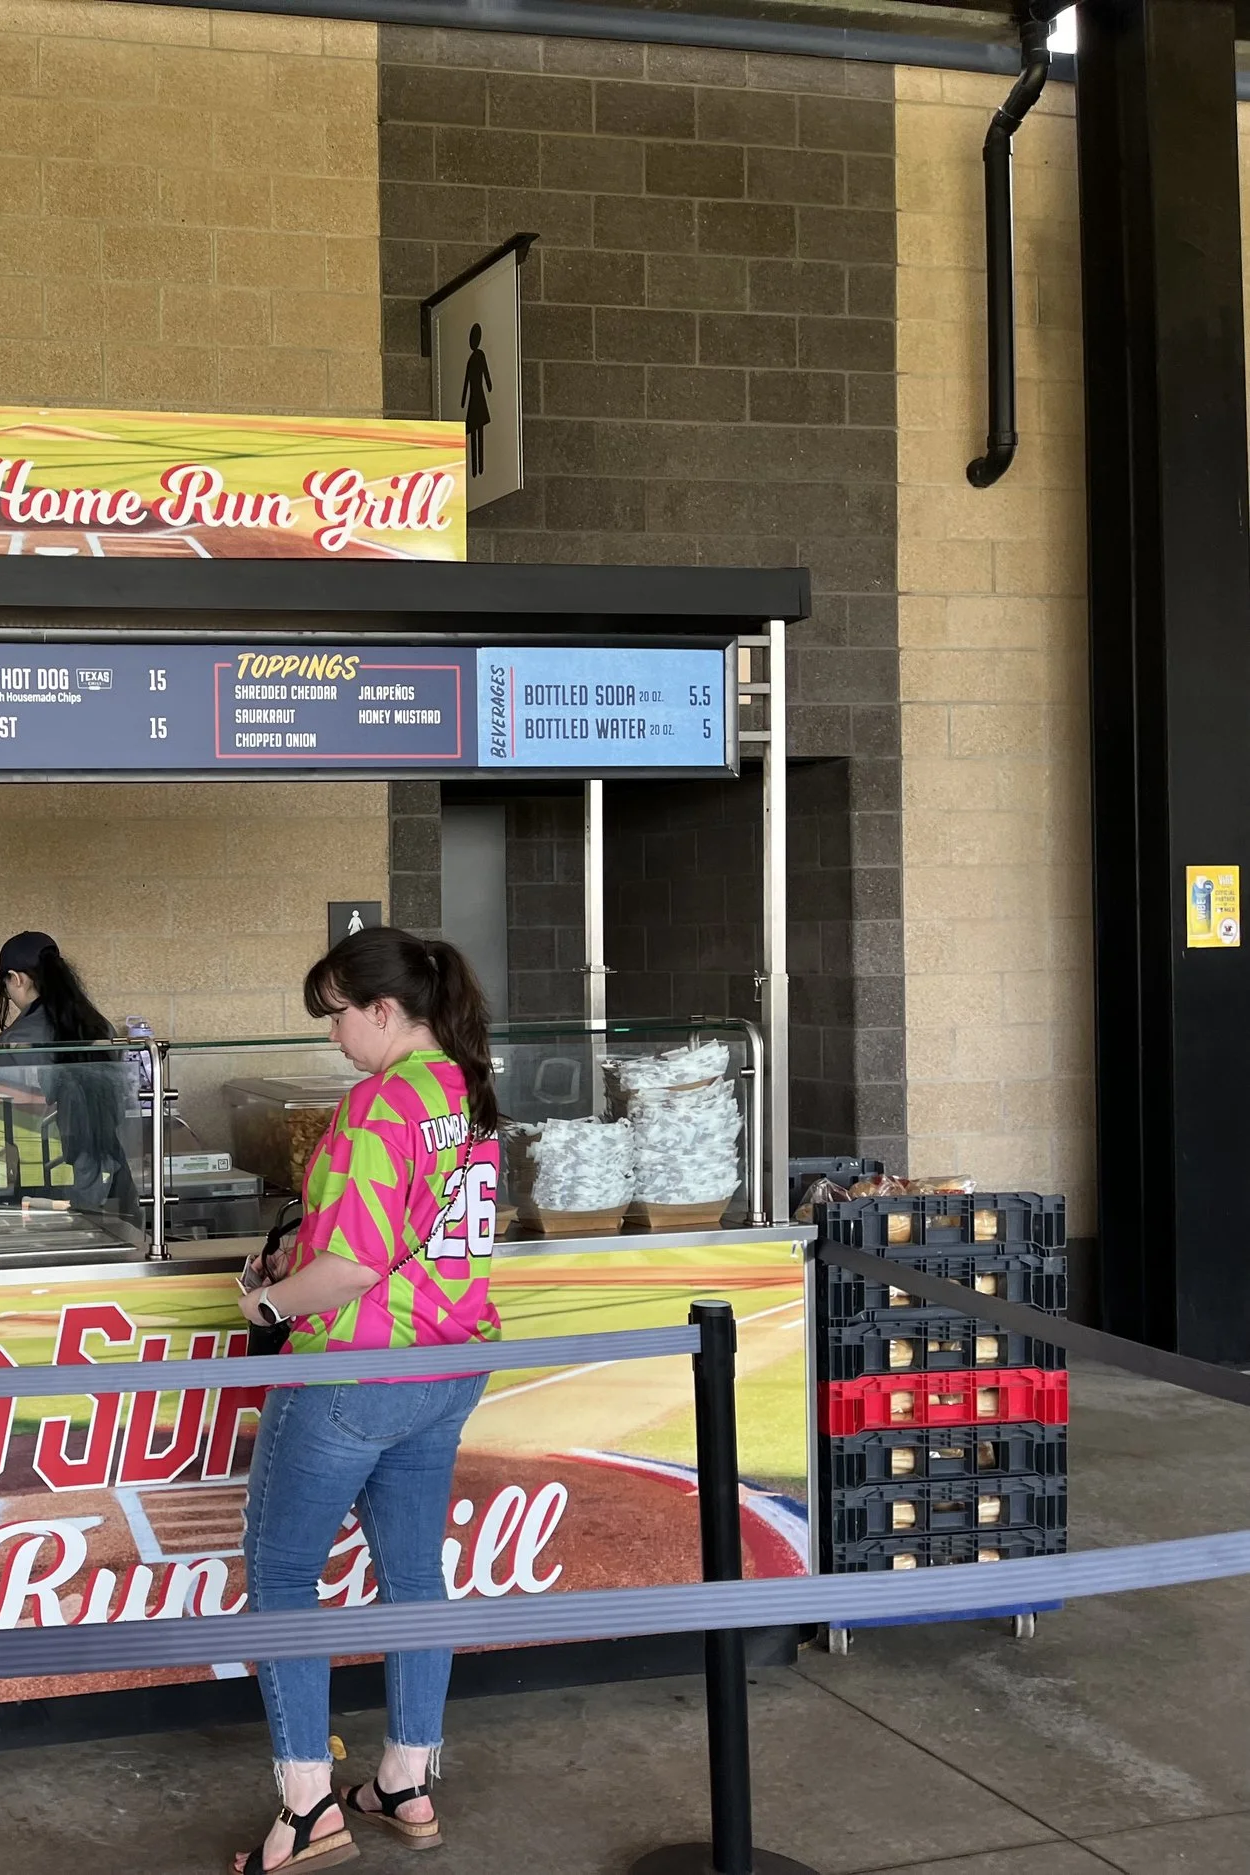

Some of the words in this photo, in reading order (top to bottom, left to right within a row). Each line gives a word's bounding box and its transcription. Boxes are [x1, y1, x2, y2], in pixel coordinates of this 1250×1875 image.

[151, 463, 299, 529] Run
[303, 467, 457, 552] Grill
[78, 671, 110, 683] TEXAS
[237, 652, 360, 681] TOPPINGS
[1, 668, 32, 689] HOT
[37, 668, 69, 690] DOG
[148, 669, 167, 691] 15
[6, 692, 57, 703] Housemade
[57, 692, 82, 705] Chips
[235, 685, 287, 700] SHREDDED
[290, 685, 338, 700] CHEDDAR
[358, 684, 415, 701] JALAPEÑOS
[524, 684, 588, 706] BOTTLED
[595, 684, 636, 706] SODA
[639, 691, 649, 702] 20
[652, 691, 664, 702] OZ.
[689, 685, 711, 706] 5.5
[235, 709, 296, 724] SAURKRAUT
[358, 709, 391, 724] HONEY
[394, 709, 441, 725] MUSTARD
[490, 664, 507, 759] BEVERAGES
[149, 717, 168, 739] 15
[524, 718, 589, 739] BOTTLED
[595, 718, 646, 739] WATER
[650, 724, 660, 736] 20
[662, 724, 675, 736] OZ.
[703, 718, 712, 739] 5
[235, 732, 283, 748] CHOPPED
[285, 732, 317, 748] ONION
[425, 1161, 497, 1261] 26
